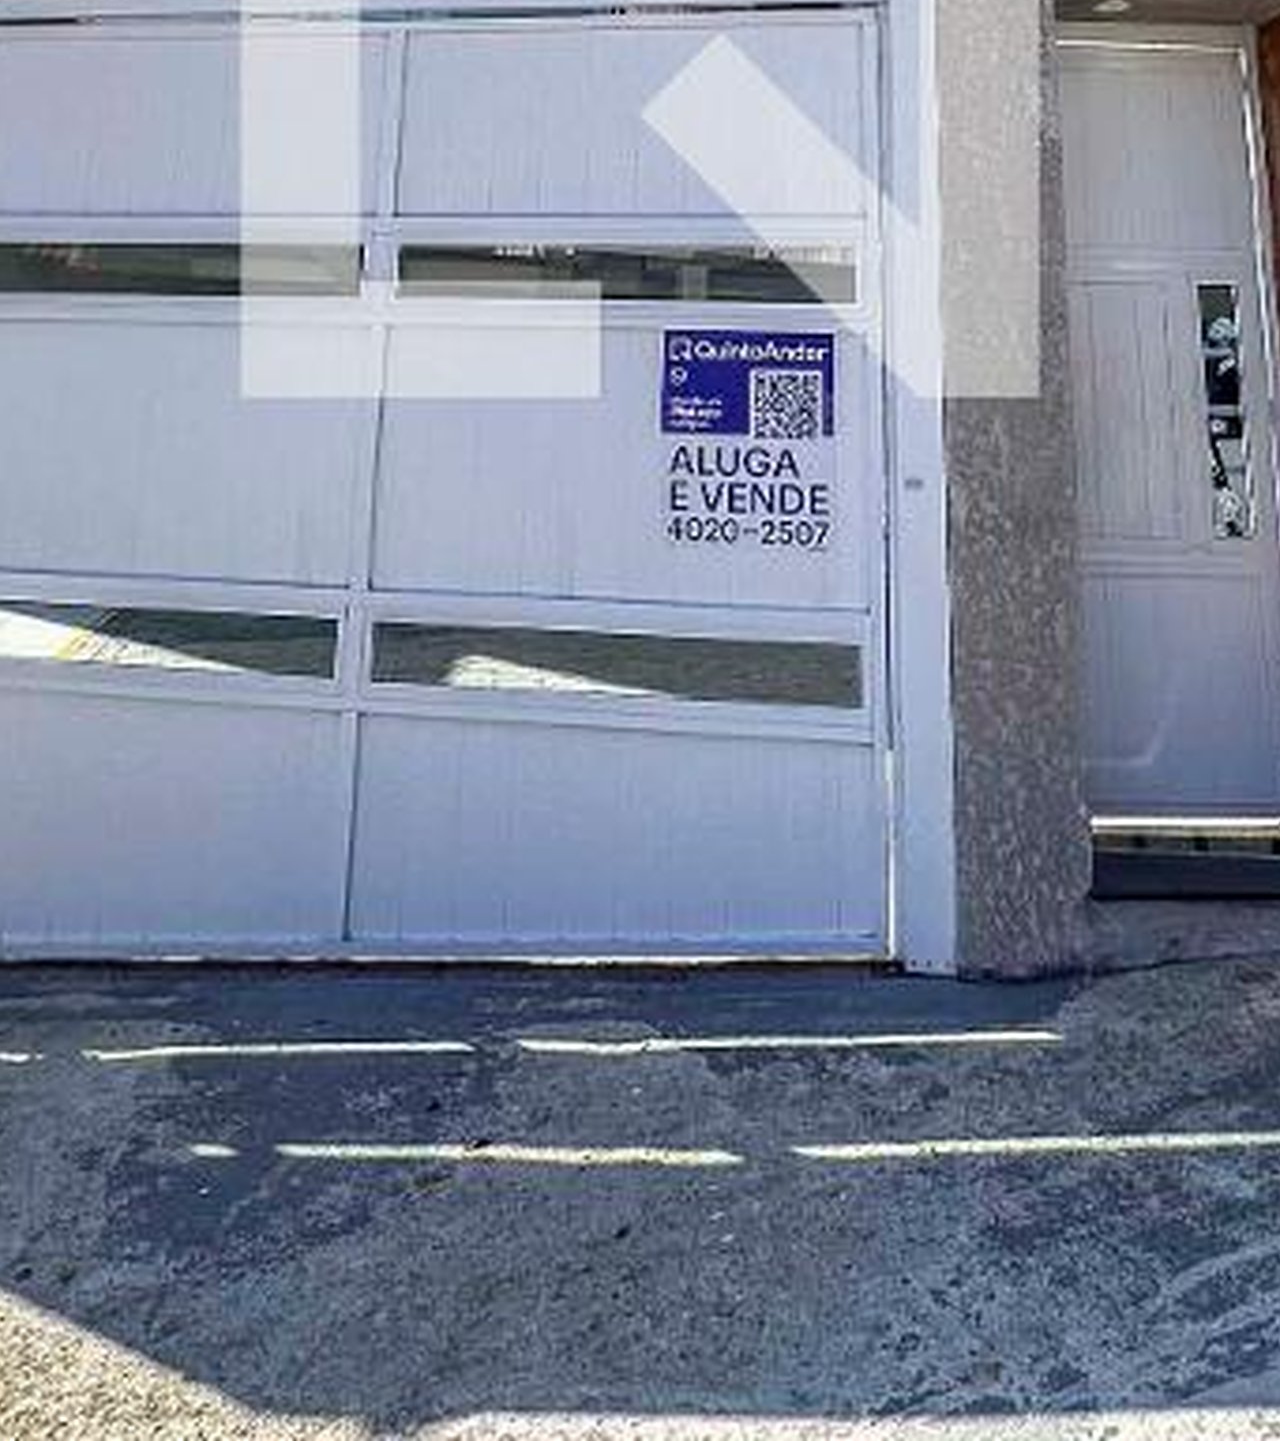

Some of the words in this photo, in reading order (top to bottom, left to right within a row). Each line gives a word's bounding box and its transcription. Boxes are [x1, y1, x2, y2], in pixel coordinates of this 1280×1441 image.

[671, 445, 799, 477] ALUGA
[671, 480, 688, 511] E
[701, 483, 830, 515] VENDE
[668, 516, 829, 546] 4020-2507
